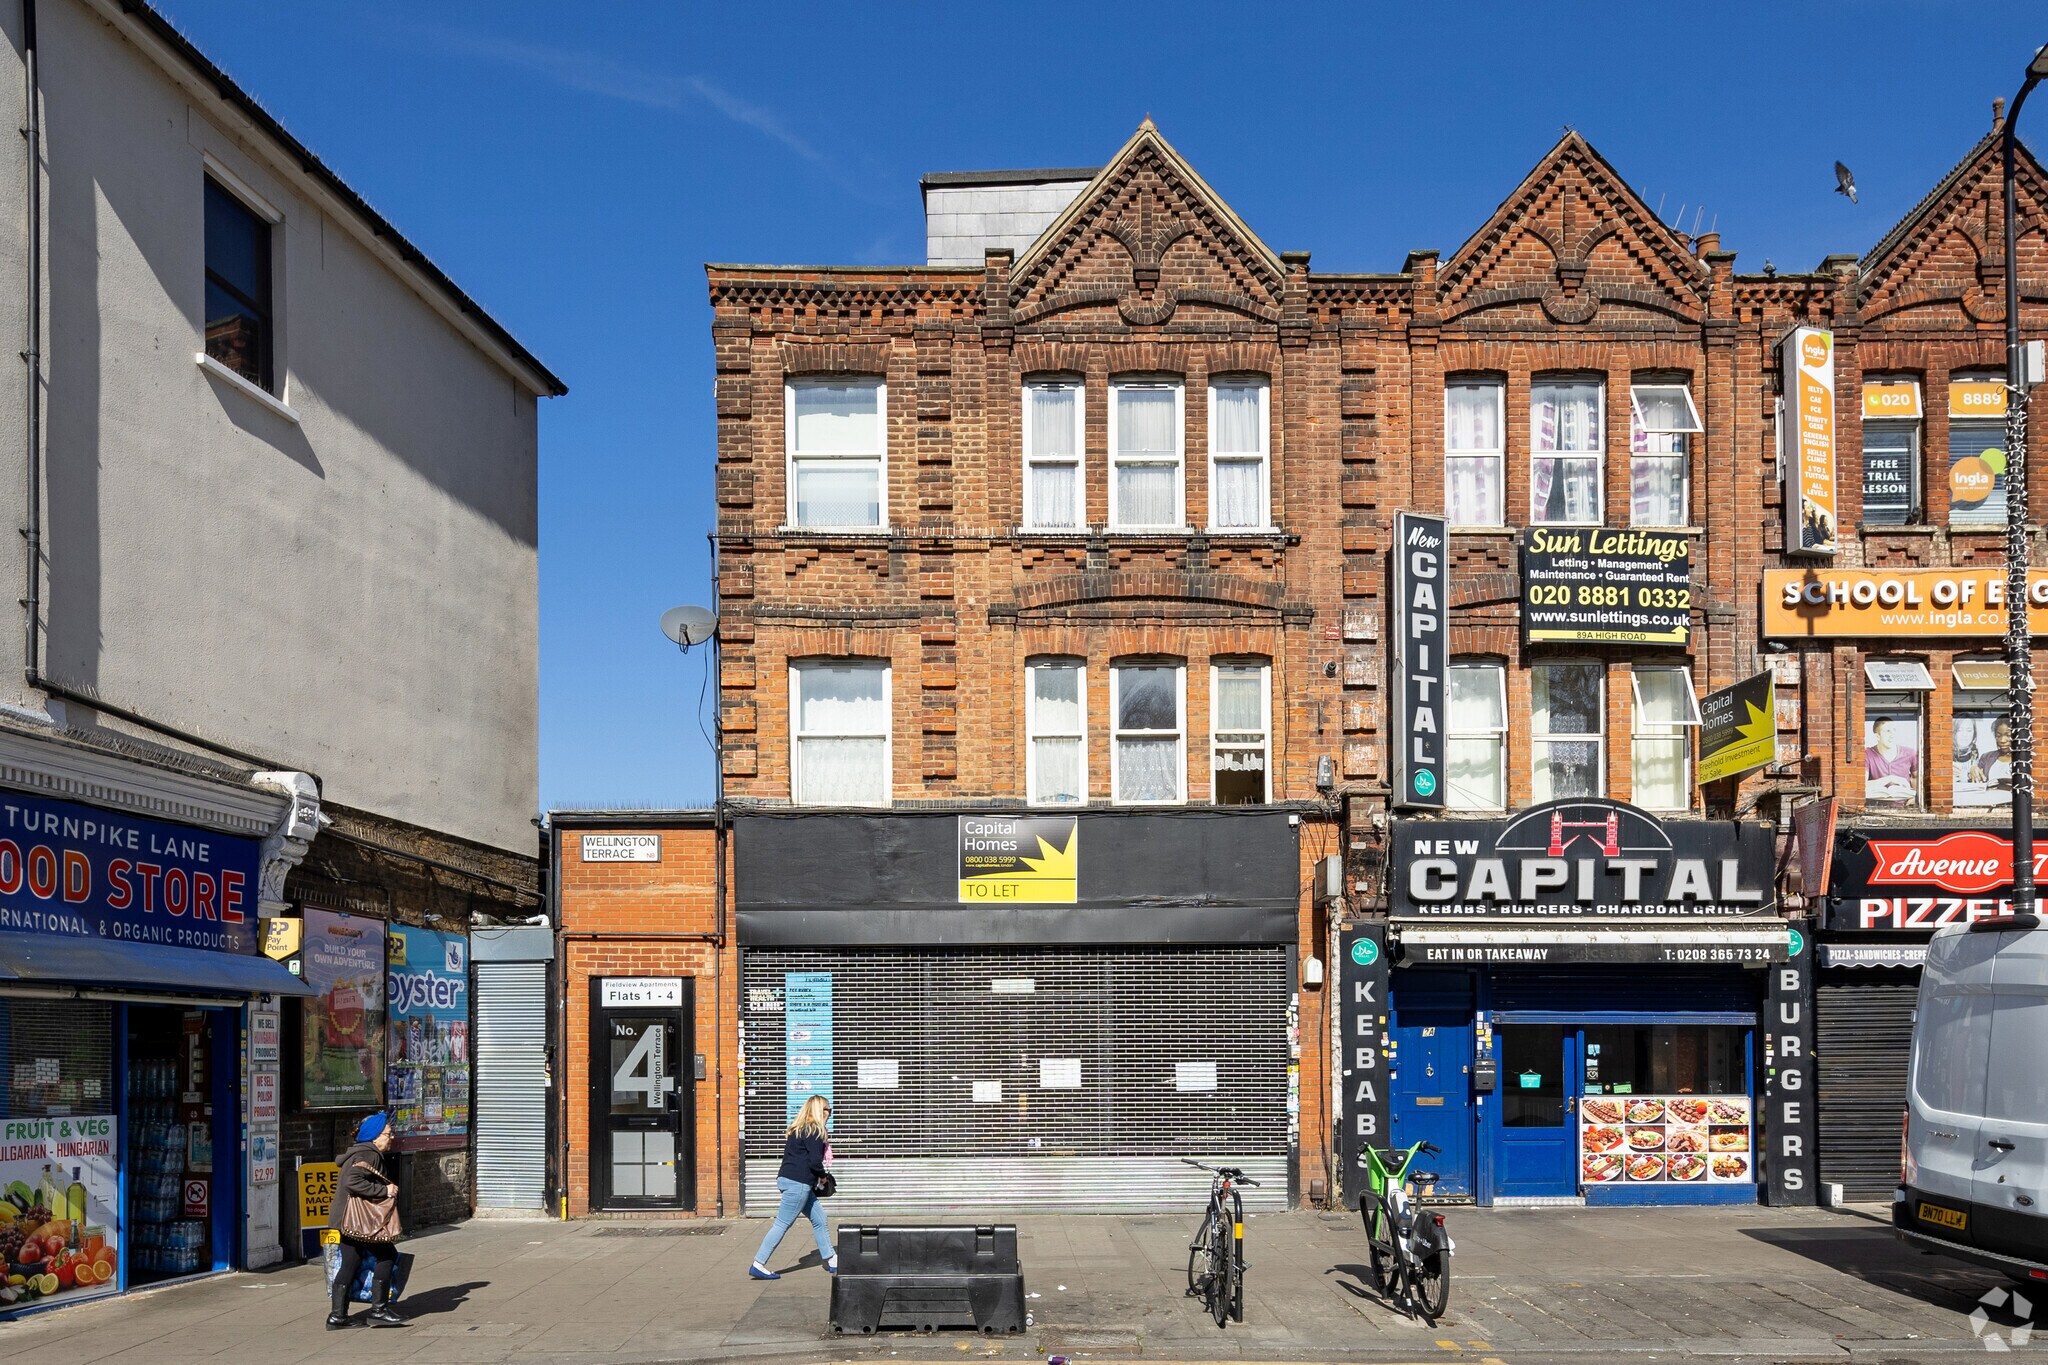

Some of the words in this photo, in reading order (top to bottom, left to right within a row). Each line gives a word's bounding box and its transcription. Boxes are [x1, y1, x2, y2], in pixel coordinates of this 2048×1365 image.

[1807, 385, 1824, 395] IELTS
[1881, 393, 1910, 406] 020
[1963, 392, 2001, 405] 8889
[1810, 405, 1822, 414] FCE
[1804, 415, 1828, 425] TRINITY
[1802, 431, 1830, 441] GENERAL
[1804, 438, 1830, 448] ENGLISH
[1806, 448, 1827, 458] SKILLS
[1806, 455, 1827, 465] CLINIC
[1870, 459, 1898, 469] FREE
[1804, 471, 1830, 481] TUITION
[1867, 472, 1901, 481] TRIAL
[1811, 482, 1823, 491] ALL
[1862, 484, 1907, 494] LESSON
[1806, 488, 1829, 498] LEVELS
[1407, 526, 1442, 549] New
[1529, 528, 1582, 554] Sun
[1588, 529, 1689, 563] Lettings
[1551, 557, 1589, 570] Letting
[1597, 558, 1663, 571] Management
[1529, 569, 1597, 580] Maintenance
[1605, 571, 1664, 582] Guaranteed
[1666, 573, 1690, 583] Rent
[1529, 585, 1571, 605] 020
[1578, 585, 1629, 606] 8881
[1638, 587, 1690, 609] 0332
[1783, 579, 1923, 605] SCHOOL
[1932, 579, 1977, 605] OF
[1530, 610, 1691, 627] www.sunlettings.co.uk
[1881, 611, 2014, 628] www.ingla.co.
[1576, 631, 1594, 639] 89A
[1595, 632, 1618, 640] HIGH
[1620, 632, 1646, 641] ROAD
[1411, 551, 1438, 764] CAPITAL
[1701, 691, 1733, 716] Capital
[1701, 710, 1734, 733] Homes
[1699, 757, 1724, 772] Freehold
[1724, 745, 1761, 763] Investment
[1699, 771, 1708, 781] For
[1709, 768, 1722, 778] Sale
[5, 805, 139, 850] TURNPIKE
[150, 834, 210, 862] LANE
[965, 821, 1017, 837] Capital
[585, 837, 656, 847] WELLINGTON
[964, 838, 1017, 851] Homes
[1414, 840, 1479, 855] NEW
[585, 849, 635, 859] TERRACE
[965, 855, 984, 864] 0800
[984, 855, 998, 864] 038
[998, 855, 1017, 864] 5999
[1890, 848, 1999, 876] Avenue
[1408, 858, 1763, 902] CAPITAL
[107, 858, 245, 924] STORE
[966, 884, 988, 897] TO
[993, 884, 1020, 897] LET
[1418, 905, 1487, 914] KEBABS
[1500, 905, 1582, 914] BURGERS
[1596, 905, 1688, 914] CHARCOAL
[1693, 905, 1745, 914] GRILL
[100, 920, 107, 936] &
[113, 921, 172, 943] ORGANIC
[178, 929, 240, 950] PRODUCTS
[267, 936, 281, 945] Pay
[324, 944, 346, 957] BUILD
[347, 946, 367, 958] YOUR
[1427, 949, 1450, 960] EAT
[1451, 949, 1465, 960] IN
[1467, 949, 1483, 960] OR
[1485, 949, 1548, 960] TAKEAWAY
[1755, 949, 1770, 960] 24
[314, 954, 332, 964] OWN
[333, 956, 376, 970] ADVENTURE
[610, 991, 641, 1001] Flats
[646, 991, 652, 1000] 1
[666, 991, 674, 1000] 4
[750, 1002, 784, 1011] CLINIC
[257, 1019, 265, 1029] WE
[265, 1019, 275, 1029] SELL
[615, 1024, 637, 1036] No.
[1423, 1028, 1435, 1036] 2A
[254, 1032, 278, 1045] HUNGARIAN
[653, 1028, 662, 1059] Terrace
[255, 1048, 277, 1058] PRODUCTS
[613, 1024, 674, 1108] 4
[256, 1076, 264, 1087] WE
[264, 1075, 274, 1087] SELL
[653, 1061, 663, 1105] Wellington
[1780, 969, 1803, 1191] BURGERS
[257, 1091, 273, 1102] POLISH
[254, 1106, 276, 1117] PRODUCTS
[5, 1121, 55, 1140] FRUIT
[60, 1120, 72, 1138] &
[76, 1119, 110, 1136] VEG
[56, 1140, 109, 1157] HUNGARIAN
[254, 1167, 274, 1182] £2.99
[304, 1171, 338, 1183] FRE
[305, 1183, 337, 1195] CAS
[306, 1196, 334, 1204] MACH
[194, 1206, 206, 1214] dogs
[306, 1205, 330, 1216] HE
[1922, 1207, 1943, 1222] BN70
